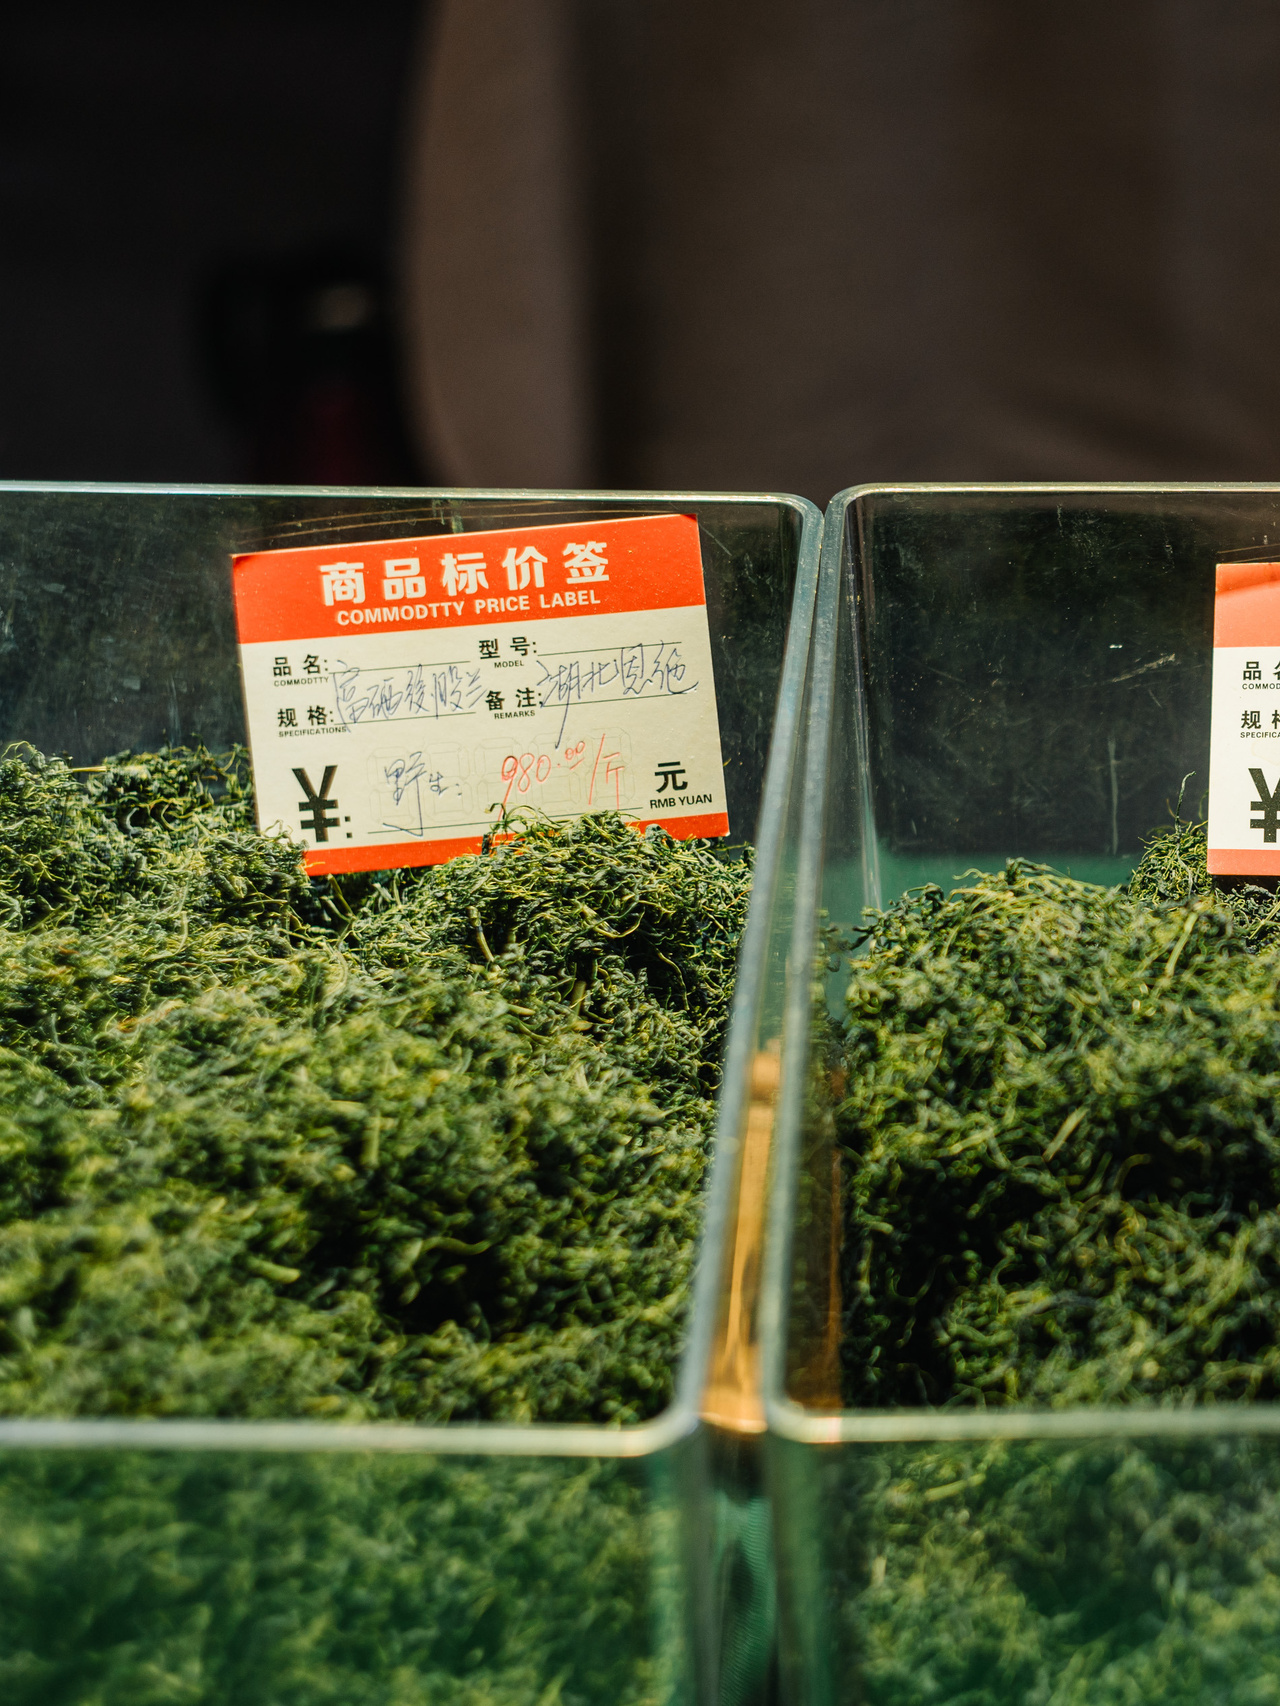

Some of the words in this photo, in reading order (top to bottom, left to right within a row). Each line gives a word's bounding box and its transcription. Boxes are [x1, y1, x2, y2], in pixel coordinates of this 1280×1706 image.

[319, 541, 610, 607] 商品标价签
[337, 601, 464, 627] COMMODTTY
[475, 596, 530, 615] PRICE
[540, 589, 601, 609] LABEL
[478, 636, 537, 660] 型号:
[273, 654, 328, 677] 品名:
[494, 659, 525, 669] MODEL
[274, 676, 329, 687] COMMODTTY
[485, 687, 543, 711] 备注:
[277, 705, 334, 728] 规格:
[494, 709, 536, 720] REMARKS
[278, 726, 347, 738] SPECIFICATIONS
[655, 761, 688, 794] 元
[649, 797, 677, 810] RMB
[678, 793, 713, 807] YUAN
